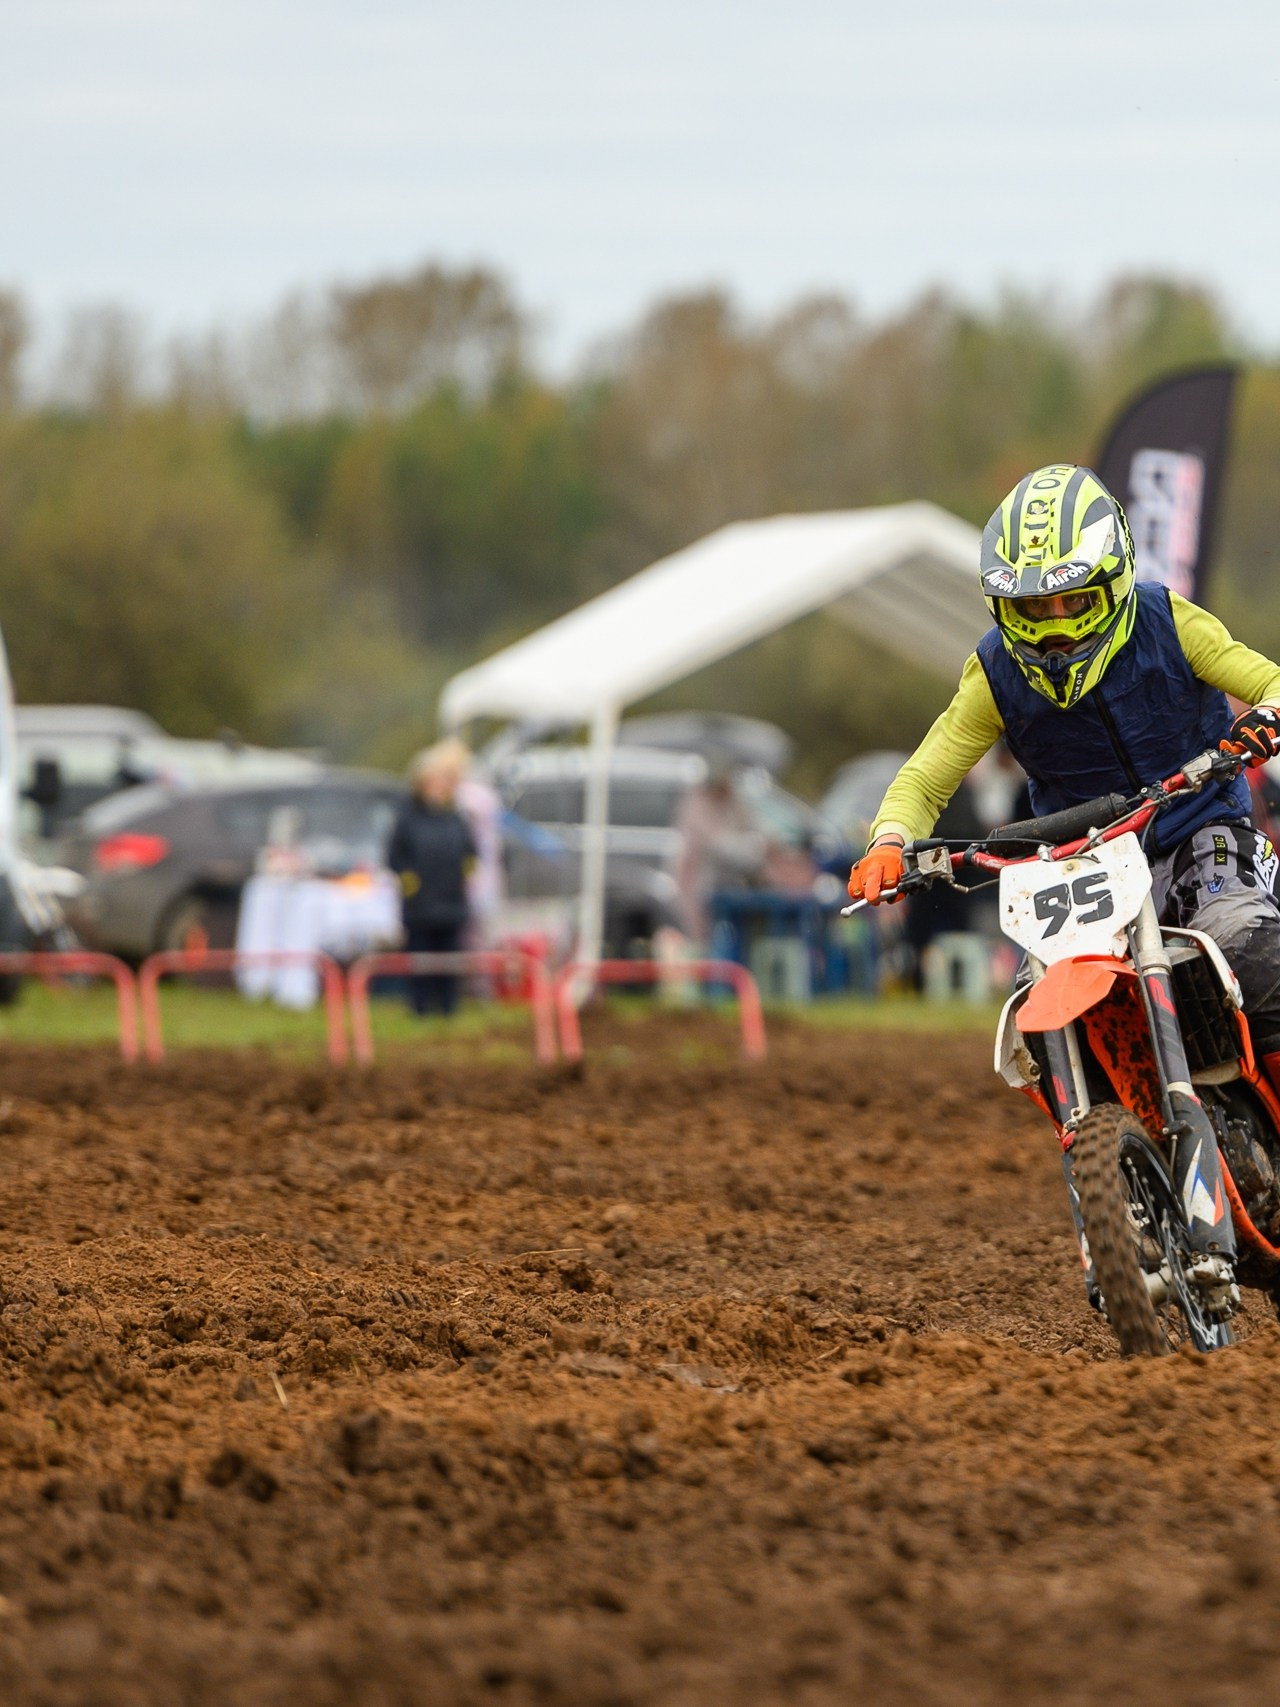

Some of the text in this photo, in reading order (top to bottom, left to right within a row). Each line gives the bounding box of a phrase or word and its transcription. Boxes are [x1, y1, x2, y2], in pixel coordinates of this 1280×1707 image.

[984, 569, 1016, 593] Airoh
[1045, 563, 1089, 590] Airoh
[1033, 871, 1115, 941] 95
